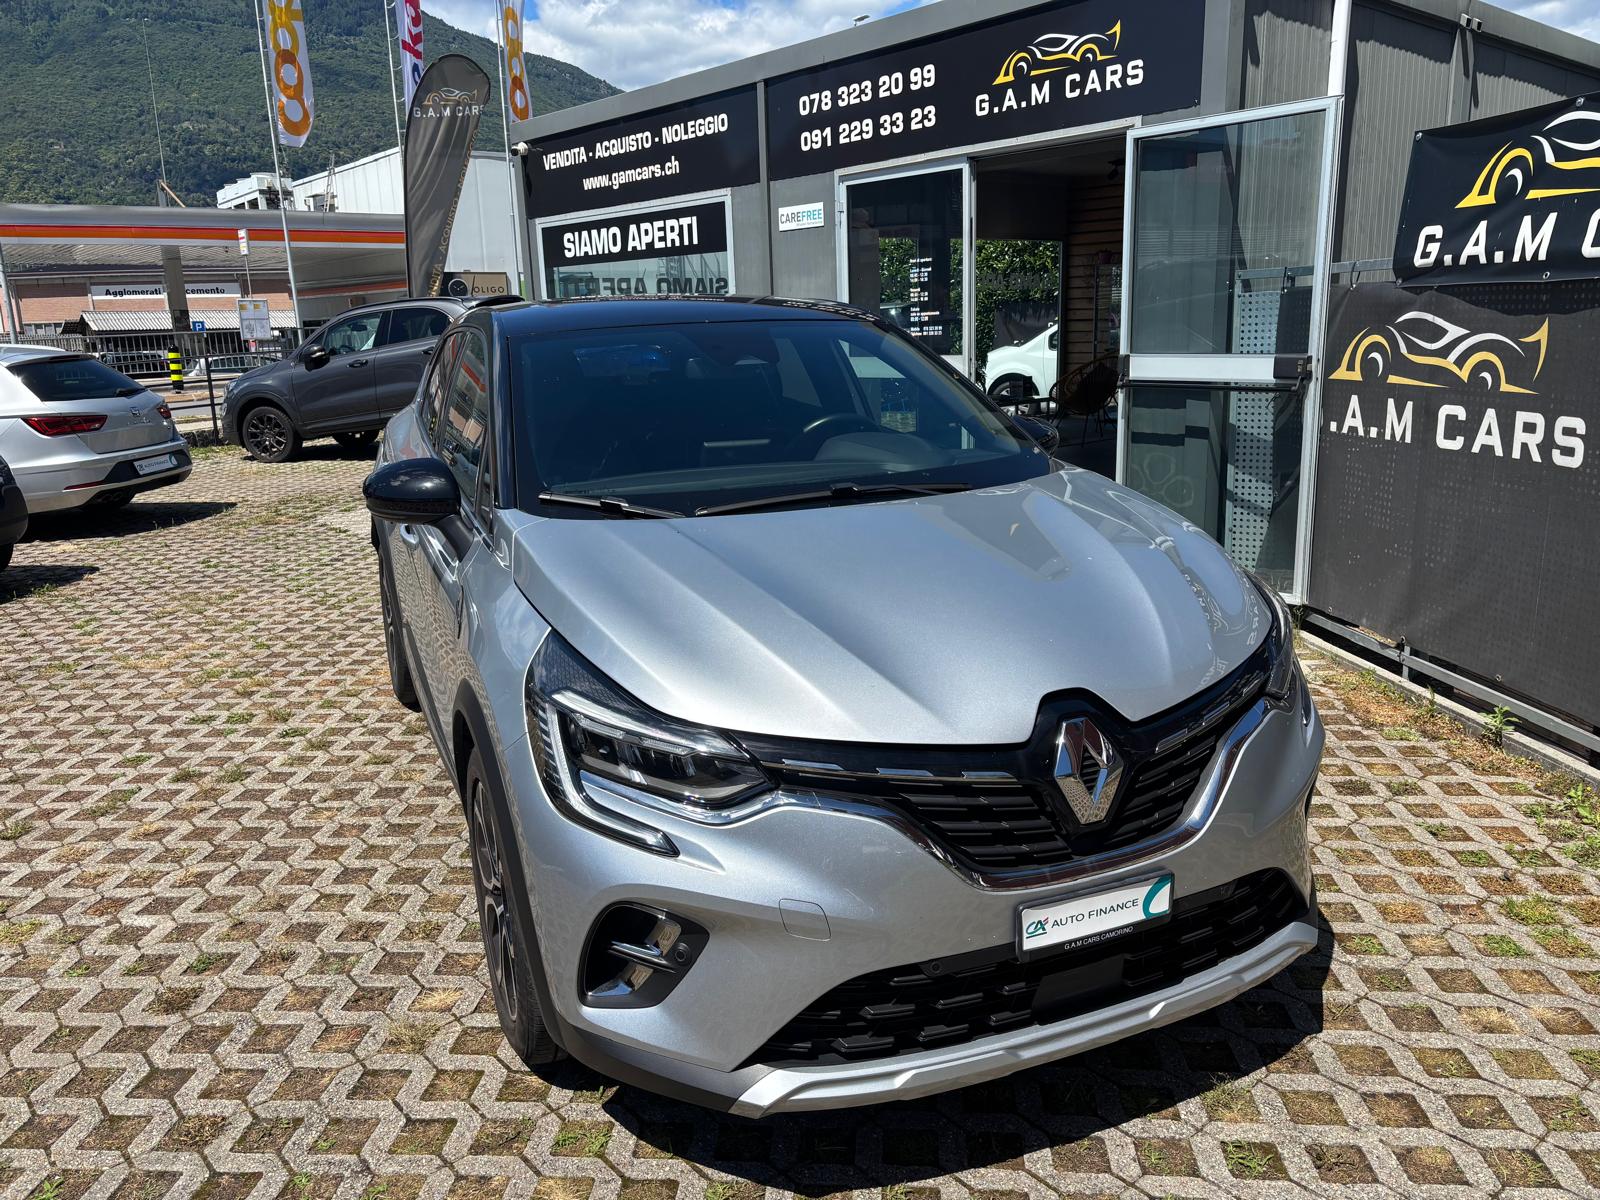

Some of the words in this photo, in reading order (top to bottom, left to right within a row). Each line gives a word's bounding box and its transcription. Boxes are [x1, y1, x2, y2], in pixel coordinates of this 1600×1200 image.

[799, 90, 832, 116] 078
[837, 80, 873, 107] 323
[878, 71, 903, 98] 20
[909, 63, 936, 91] 99
[975, 79, 1050, 117] G.A.M
[1065, 59, 1145, 98] CARS
[413, 106, 451, 118] G.A.M
[800, 126, 832, 152] 091
[839, 118, 873, 144] 229
[880, 111, 904, 136] 33
[910, 105, 936, 130] 23
[543, 146, 588, 171] VENDITA
[595, 131, 651, 159] ACQUISTO
[662, 113, 728, 144] NOLEGGIO
[582, 155, 680, 190] www.gamcars.ch
[780, 209, 823, 224] CAREFREE
[563, 227, 622, 258] SIAMO
[627, 216, 698, 251] APERTI
[1413, 212, 1558, 268] G.A.M
[105, 288, 162, 298] Agglomerati
[185, 286, 226, 295] cemento
[473, 286, 505, 294] OLIGO
[195, 322, 203, 332] P
[1321, 394, 1413, 444] .A.M
[1436, 404, 1586, 469] CARS
[1051, 913, 1085, 929] AUTO
[1088, 898, 1139, 920] FINANCE
[1083, 933, 1100, 945] CARS
[1100, 926, 1134, 940] CAMORINO
